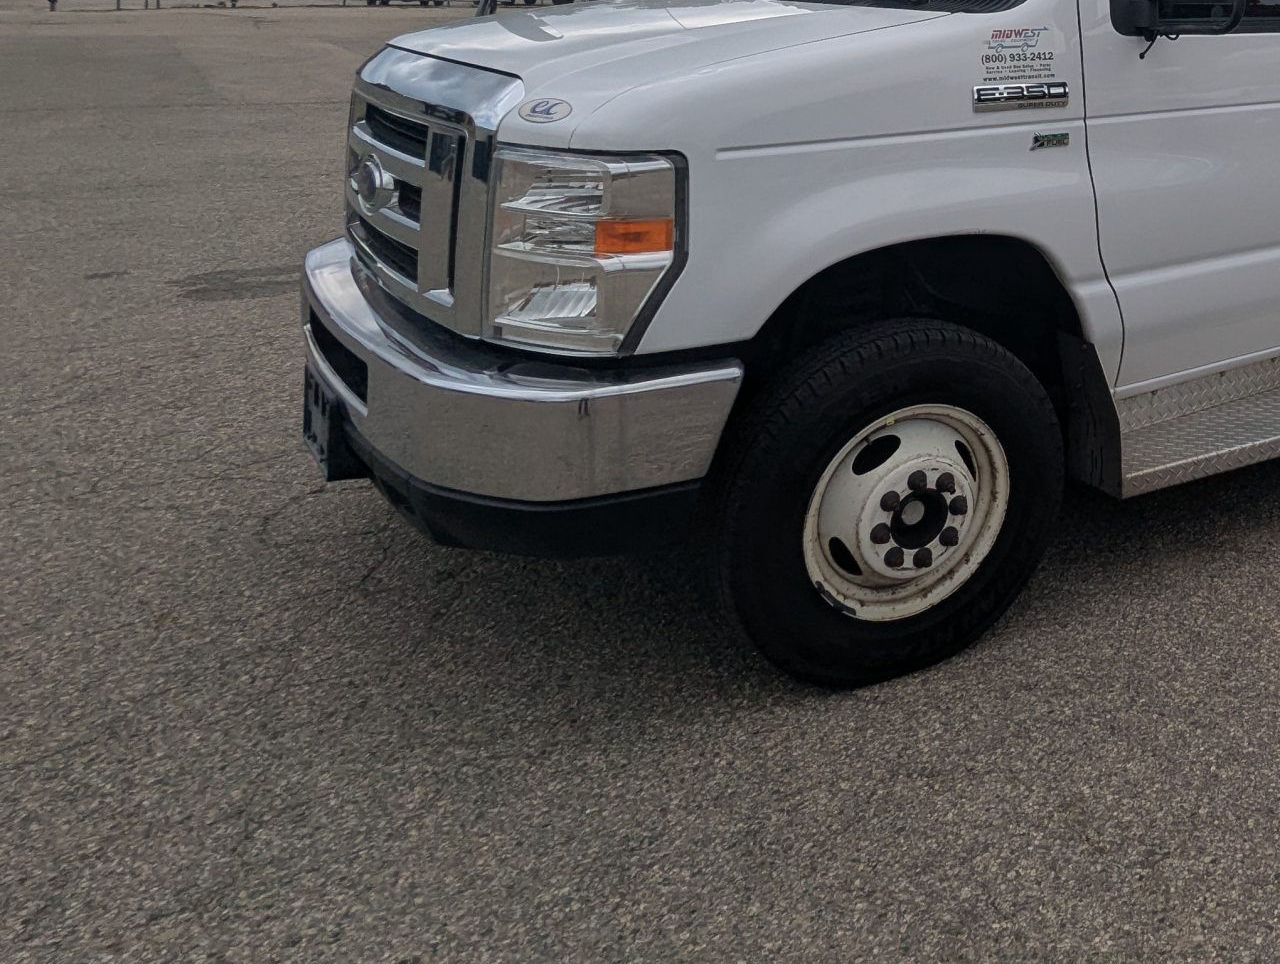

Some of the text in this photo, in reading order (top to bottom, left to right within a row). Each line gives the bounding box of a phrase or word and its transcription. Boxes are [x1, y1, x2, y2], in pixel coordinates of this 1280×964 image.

[991, 26, 1048, 39] MIDWEST
[981, 52, 1054, 65] (800) 933-2412
